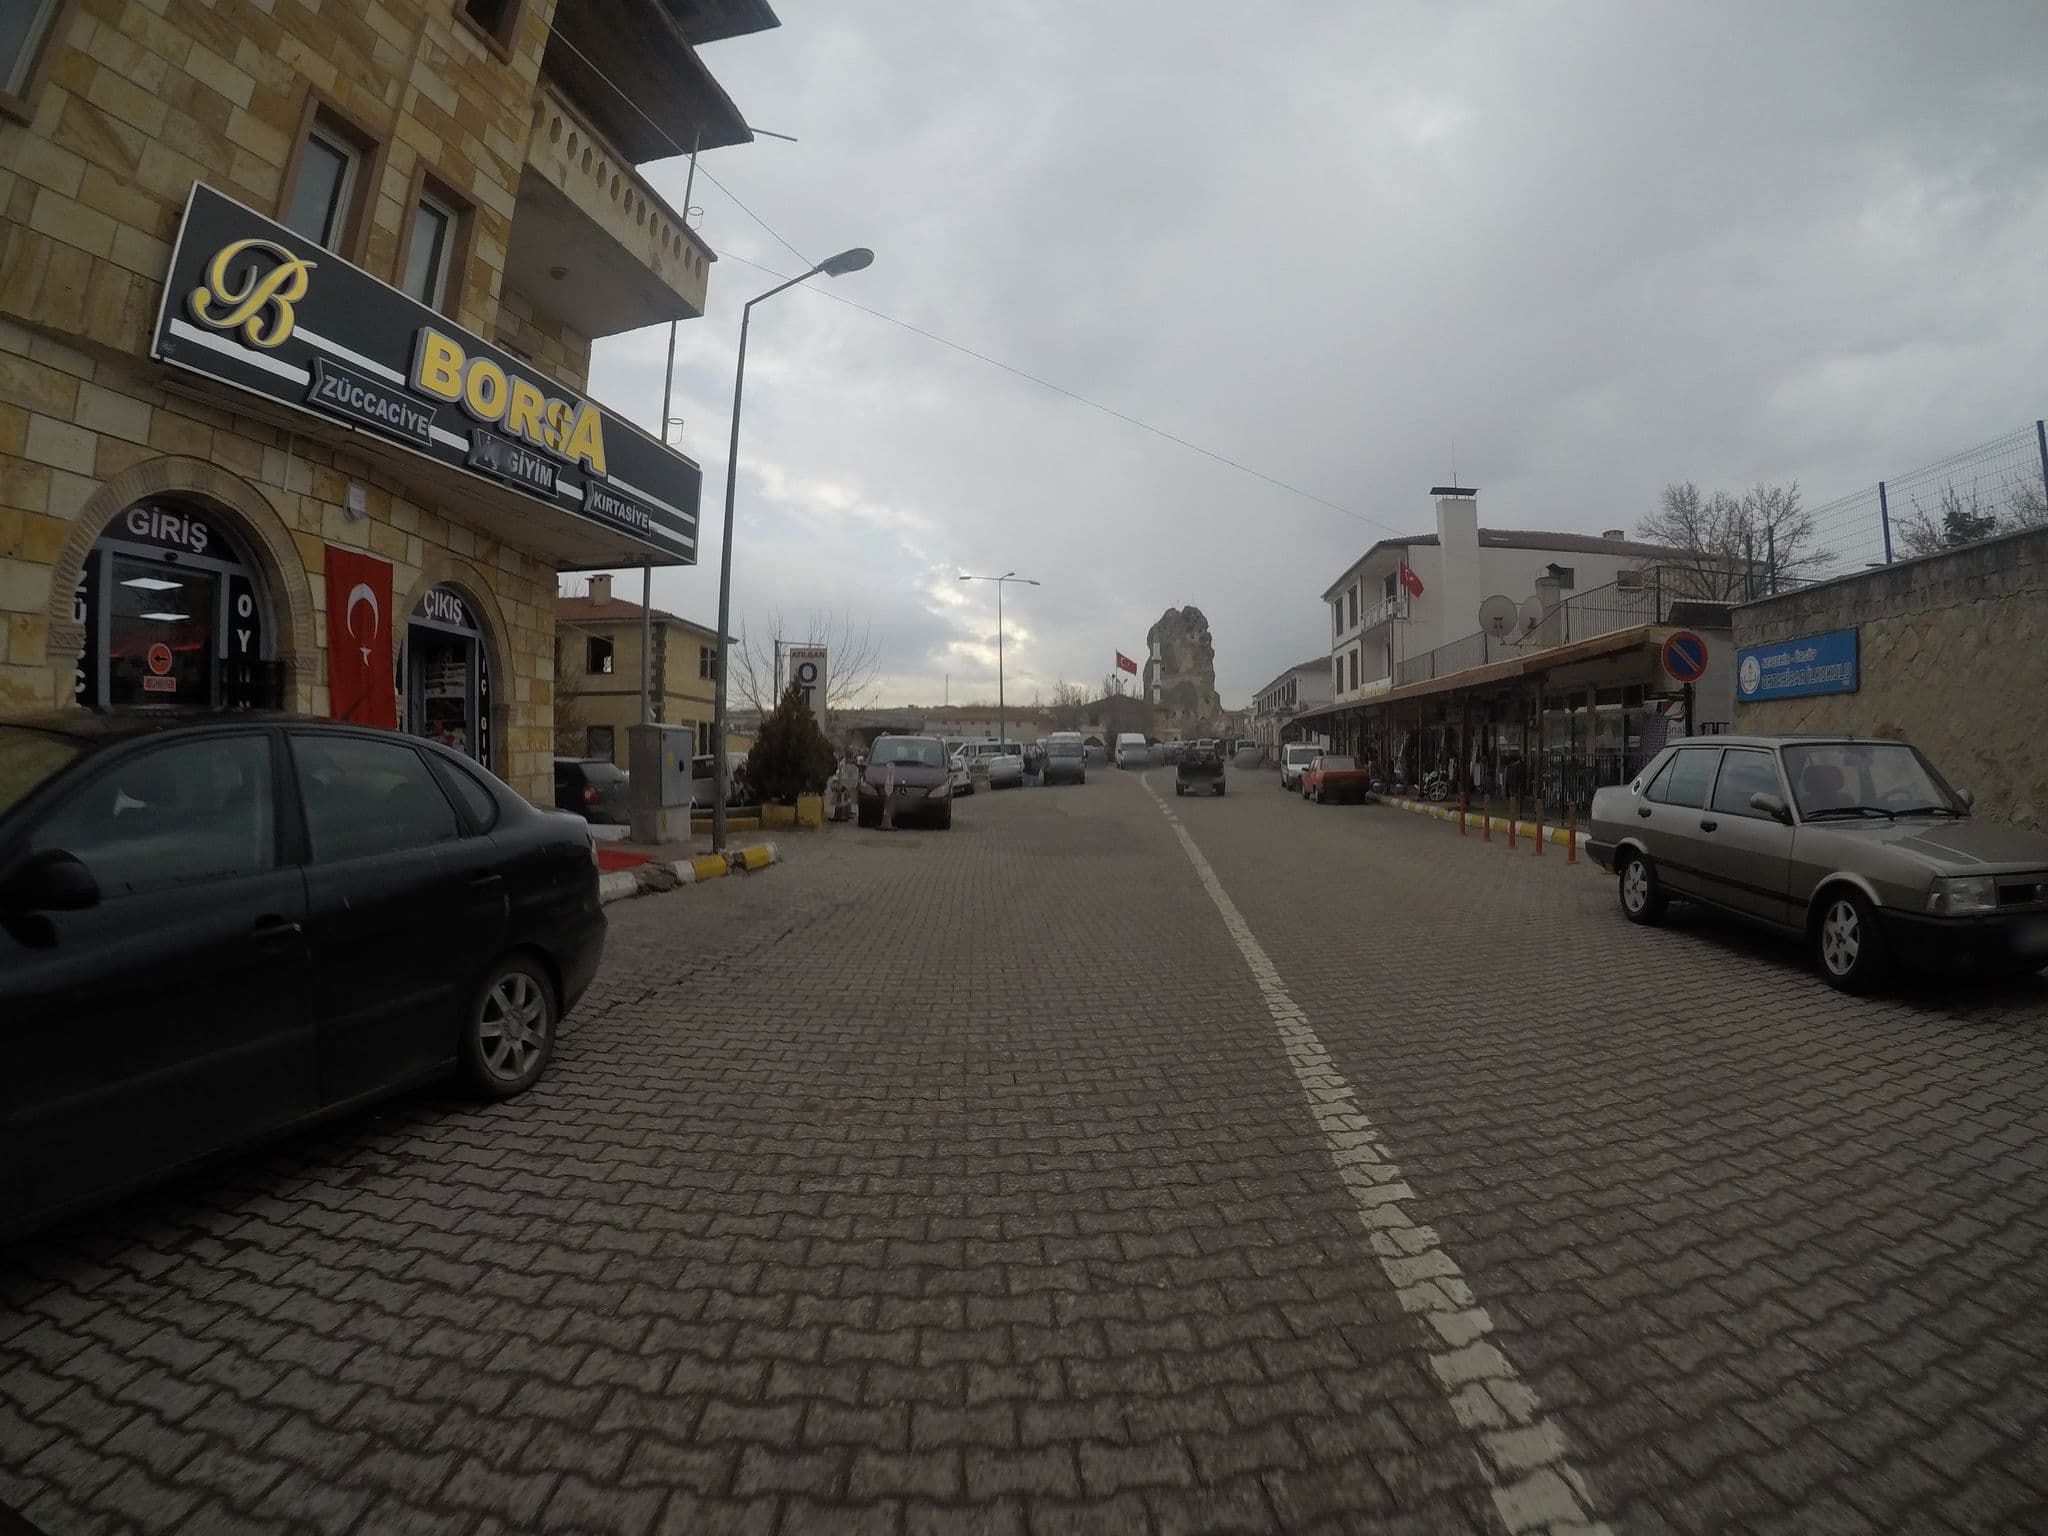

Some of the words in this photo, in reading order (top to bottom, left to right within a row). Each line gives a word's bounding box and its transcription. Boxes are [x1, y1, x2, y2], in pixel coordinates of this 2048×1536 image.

[187, 237, 318, 349] B
[321, 373, 430, 438] ZÜCCACİYE
[127, 506, 209, 553] GİRİŞ
[592, 490, 650, 528] KIRTASİYE
[423, 589, 464, 626] ÇIKIŞ
